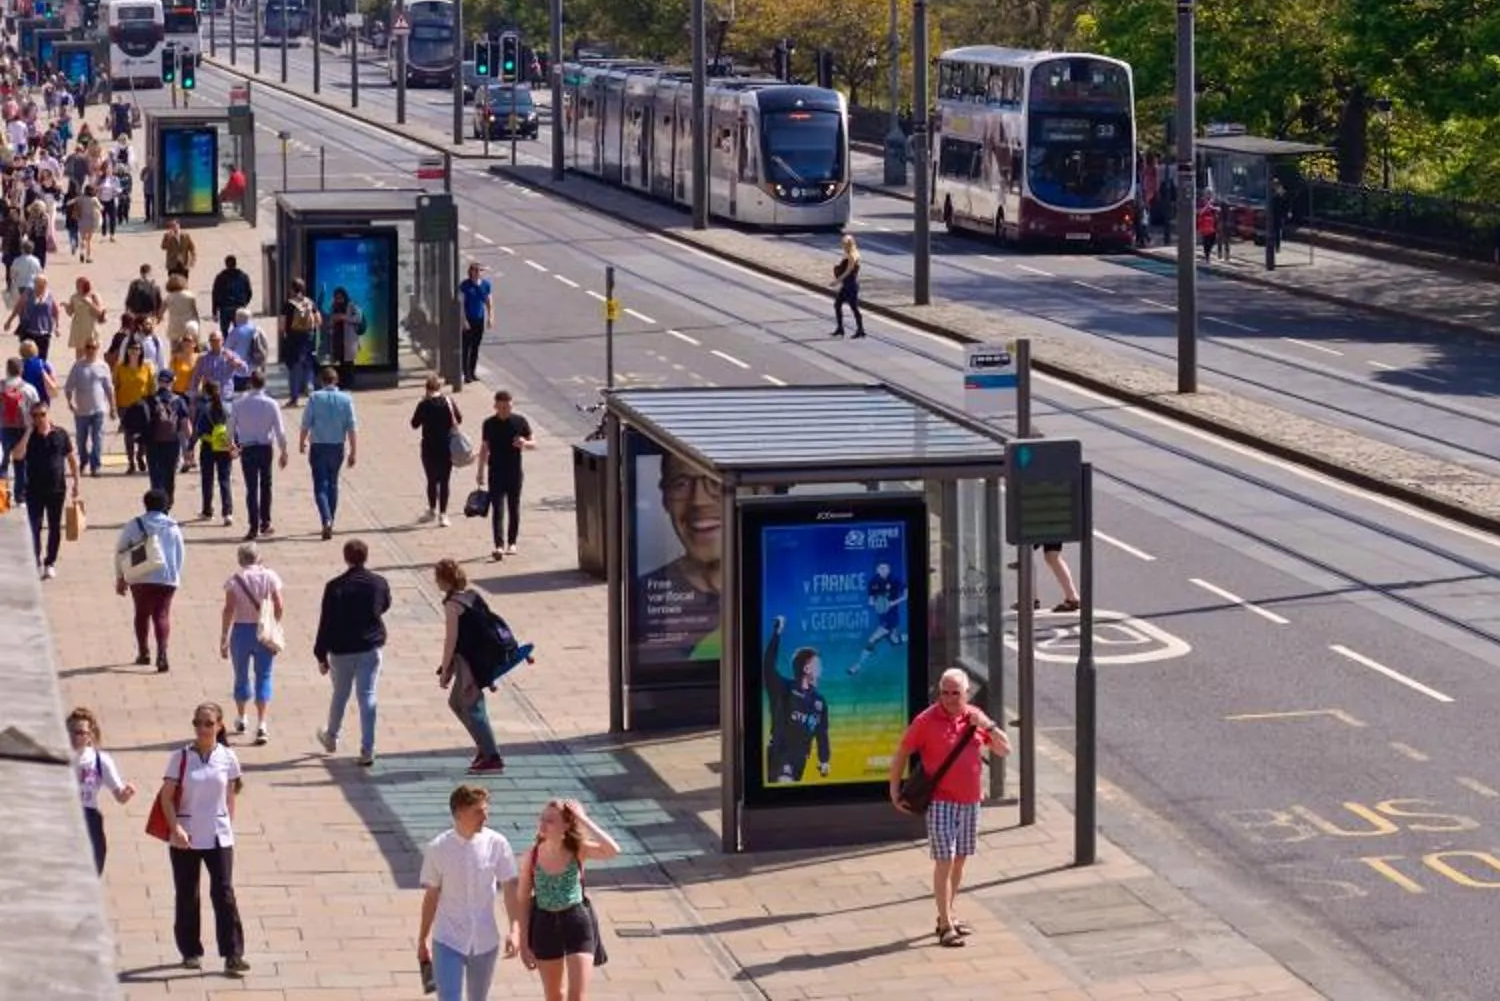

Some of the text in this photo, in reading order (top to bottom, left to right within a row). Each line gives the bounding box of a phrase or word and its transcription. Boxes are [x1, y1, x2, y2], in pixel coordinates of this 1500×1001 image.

[813, 572, 867, 593] FRANCE
[811, 610, 870, 631] GEORGIA
[1215, 798, 1481, 843] BUS
